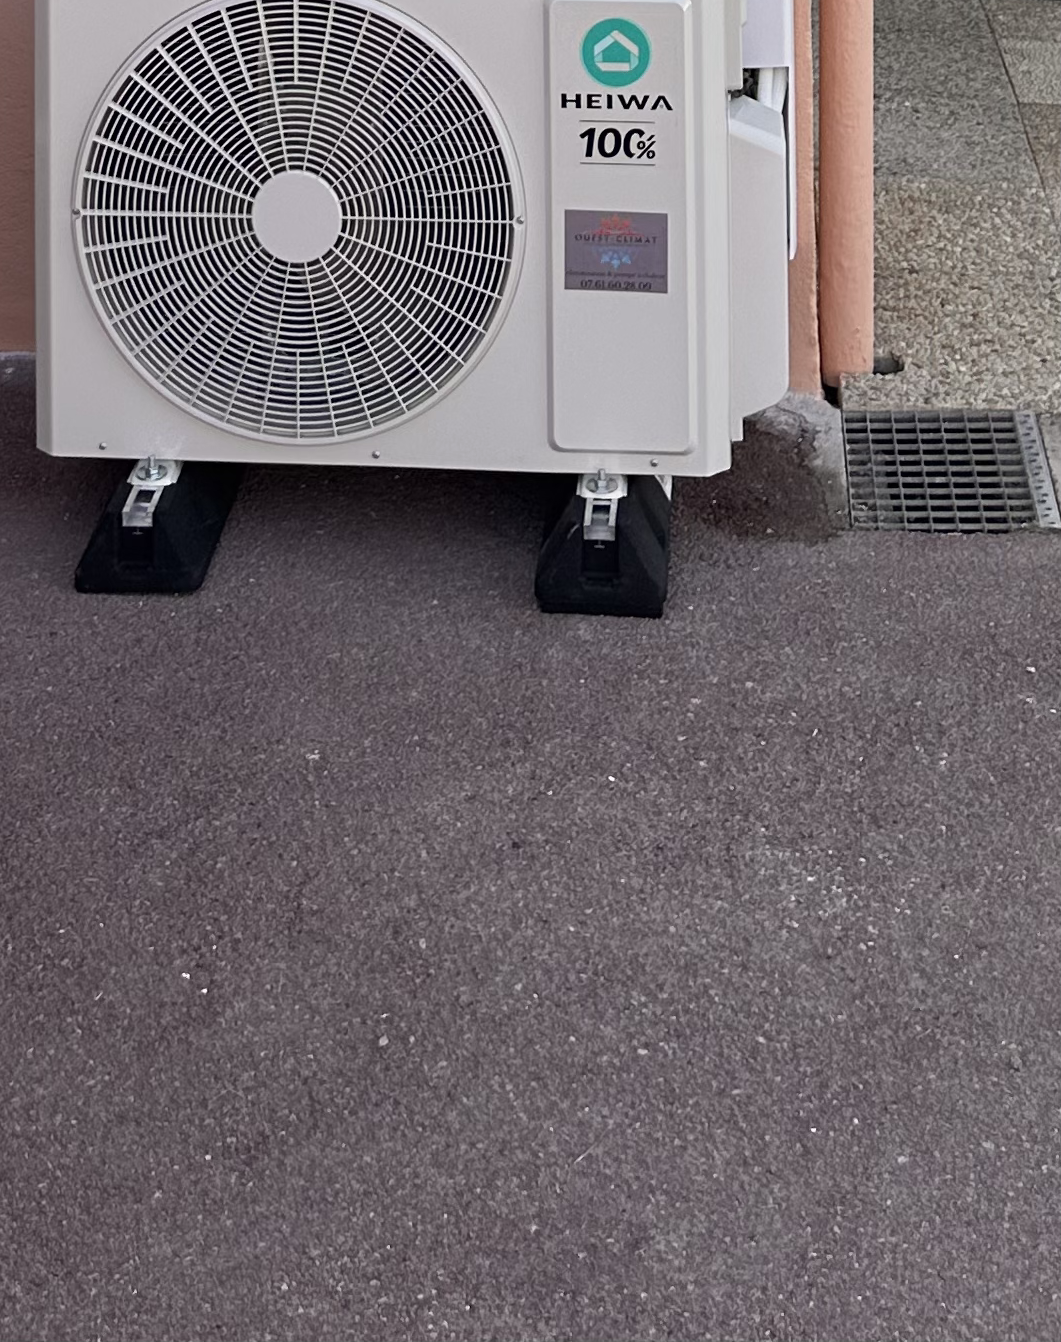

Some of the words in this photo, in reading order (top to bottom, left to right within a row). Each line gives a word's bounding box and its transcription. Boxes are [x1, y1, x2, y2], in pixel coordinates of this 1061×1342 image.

[560, 93, 673, 111] HEIWA
[579, 127, 656, 159] 100%
[616, 234, 658, 244] CLIMAT
